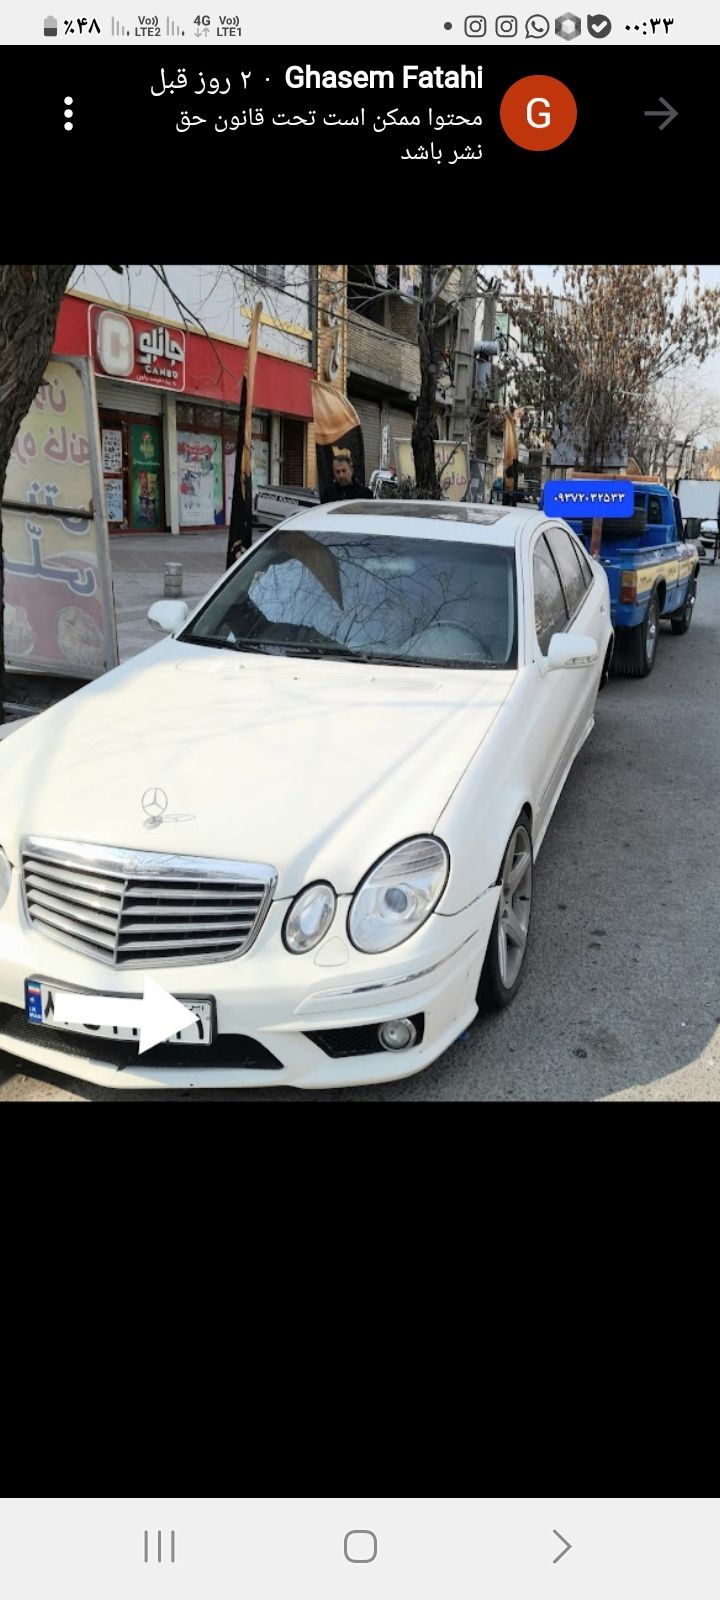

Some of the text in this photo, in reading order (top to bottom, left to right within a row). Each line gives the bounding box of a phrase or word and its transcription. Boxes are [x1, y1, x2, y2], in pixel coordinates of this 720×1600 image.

[134, 27, 162, 37] LTE2
[193, 15, 211, 27] 4G
[216, 27, 242, 37] LTE1
[624, 17, 675, 36] ۰۰:۳۳
[150, 67, 252, 97] ۲ روز قبل
[284, 64, 483, 89] Ghasem Fatahi
[175, 107, 483, 133] محتوا ممکن است تحت قانون حق
[526, 97, 551, 129] G
[400, 141, 483, 165] نشر باشد
